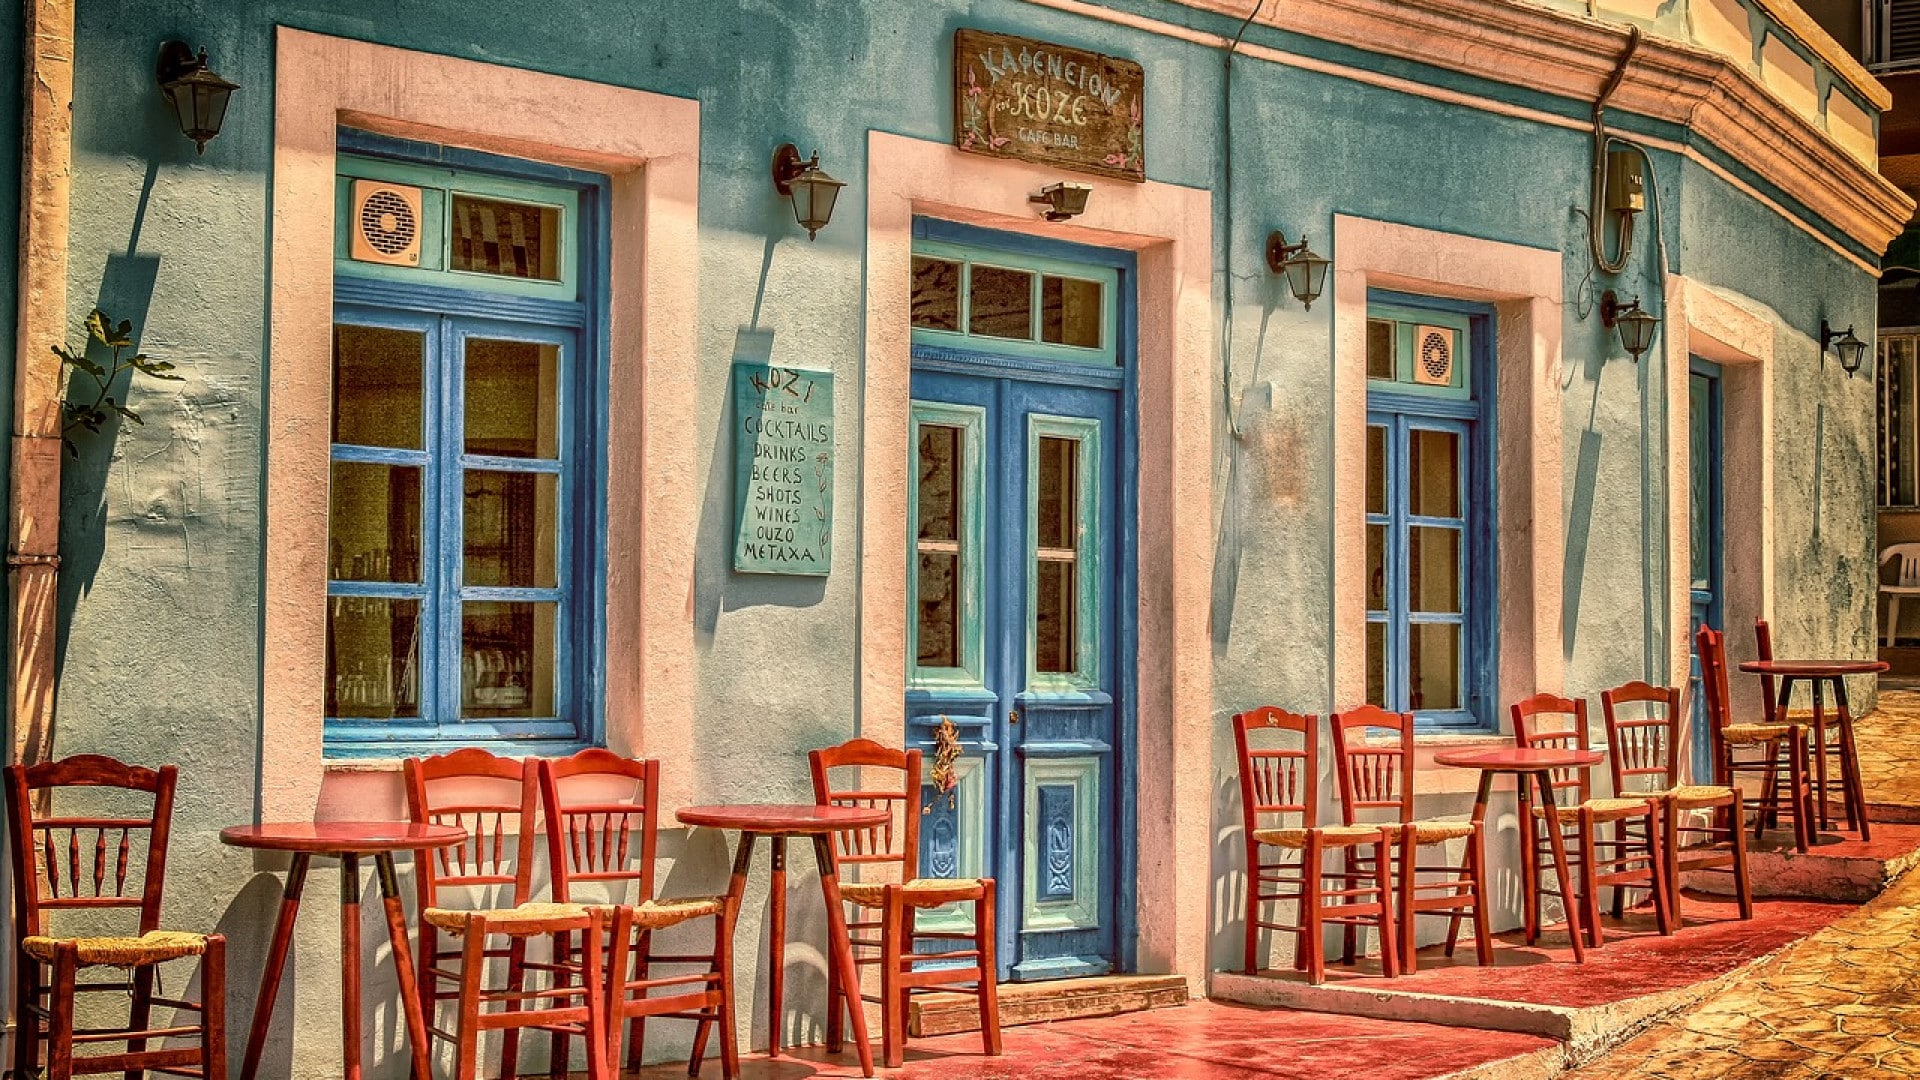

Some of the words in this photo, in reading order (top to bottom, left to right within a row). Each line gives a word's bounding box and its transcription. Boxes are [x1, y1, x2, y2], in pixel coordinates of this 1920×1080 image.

[1018, 127, 1048, 144] CAFE
[1054, 133, 1081, 150] BAR
[781, 401, 799, 414] bar
[745, 416, 829, 443] COCKTAILS
[754, 441, 806, 463] DRINKS
[751, 464, 803, 484] BEERS
[756, 486, 802, 504] SHOTS
[755, 506, 800, 523] WINES
[757, 526, 795, 543] OUZO
[744, 543, 816, 562] METAXA
